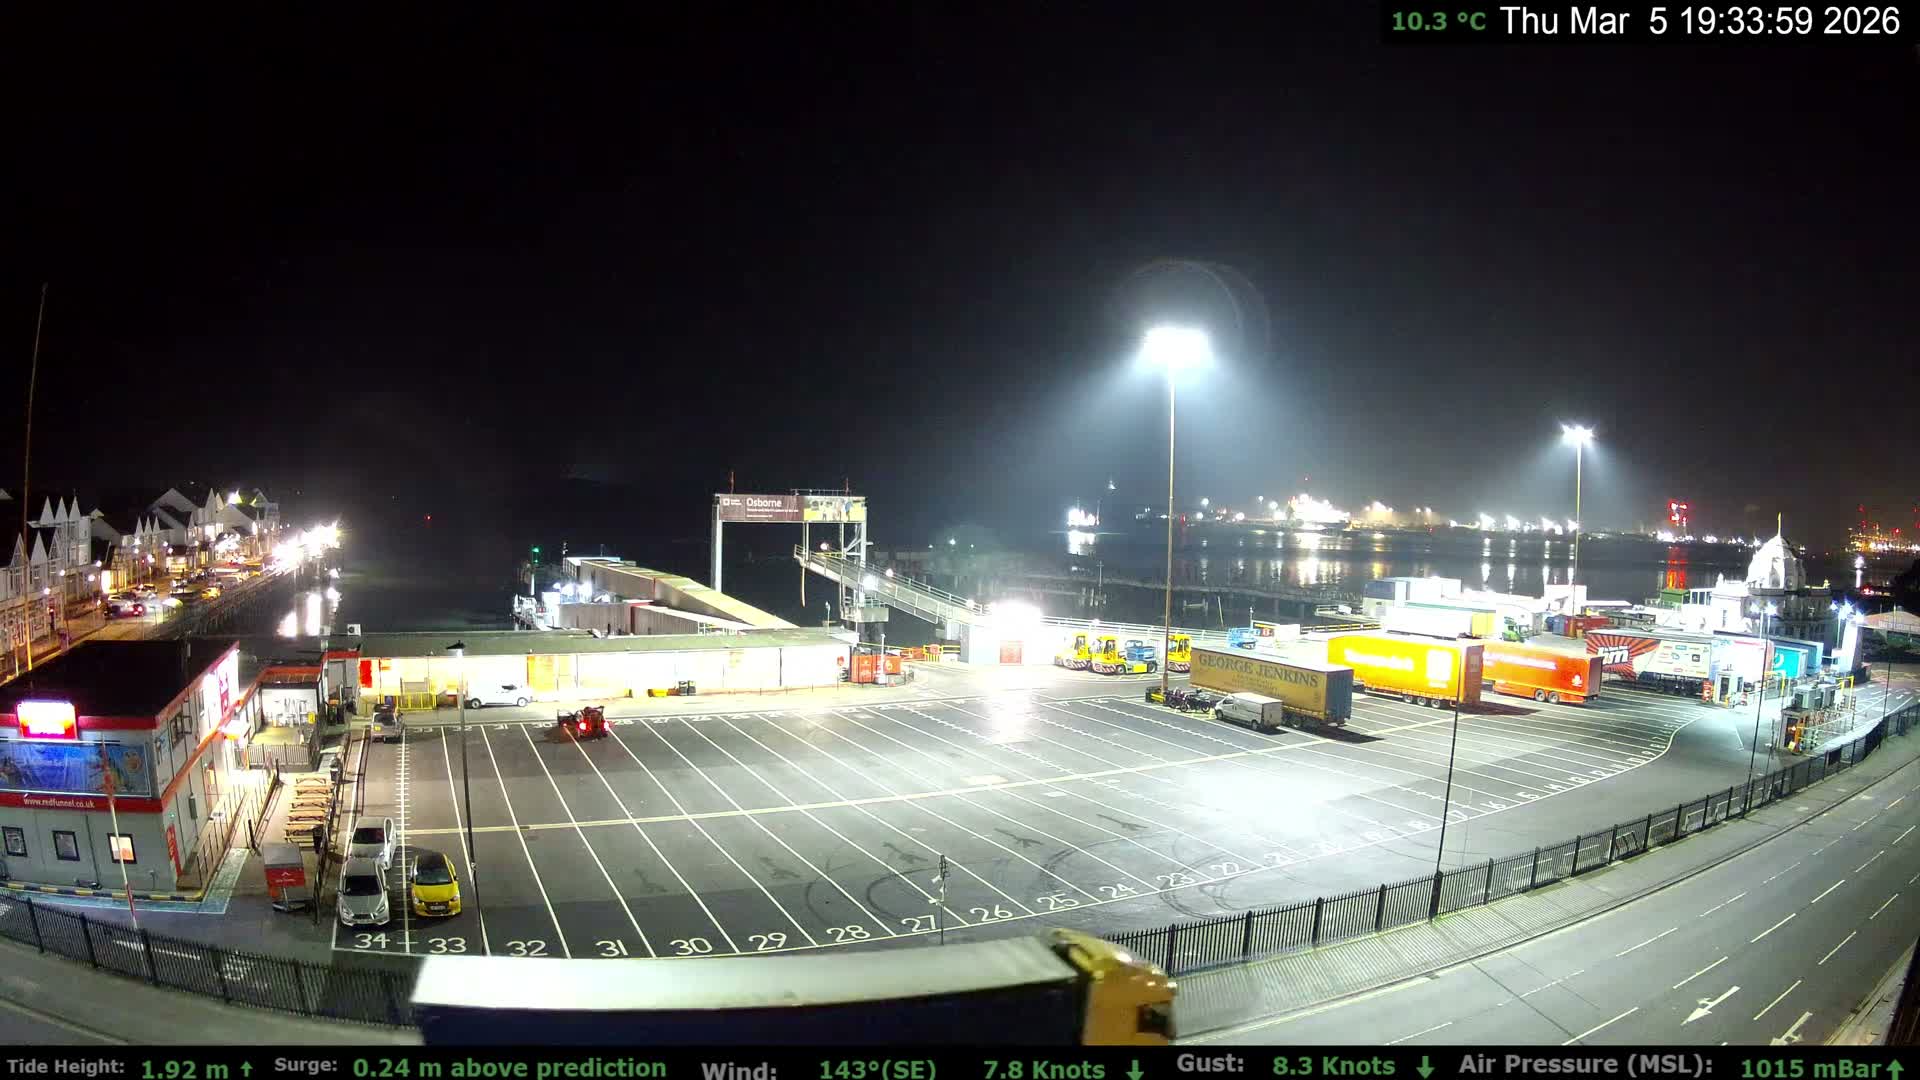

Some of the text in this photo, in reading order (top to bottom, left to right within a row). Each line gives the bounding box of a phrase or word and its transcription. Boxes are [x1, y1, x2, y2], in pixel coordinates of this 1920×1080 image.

[746, 497, 782, 507] Osborne
[1199, 653, 1254, 675] GEORGE
[1256, 663, 1319, 688] JENKINS
[1156, 872, 1196, 887] 23
[1098, 883, 1137, 899] 24
[1036, 893, 1080, 911] 25
[969, 905, 1013, 922] 26
[901, 915, 938, 933] 27
[354, 932, 391, 950] 34
[748, 932, 788, 952] 29
[826, 924, 870, 943] 28
[427, 937, 467, 954] 33
[505, 939, 549, 957] 32
[595, 939, 629, 957] 31
[669, 937, 713, 956] 30
